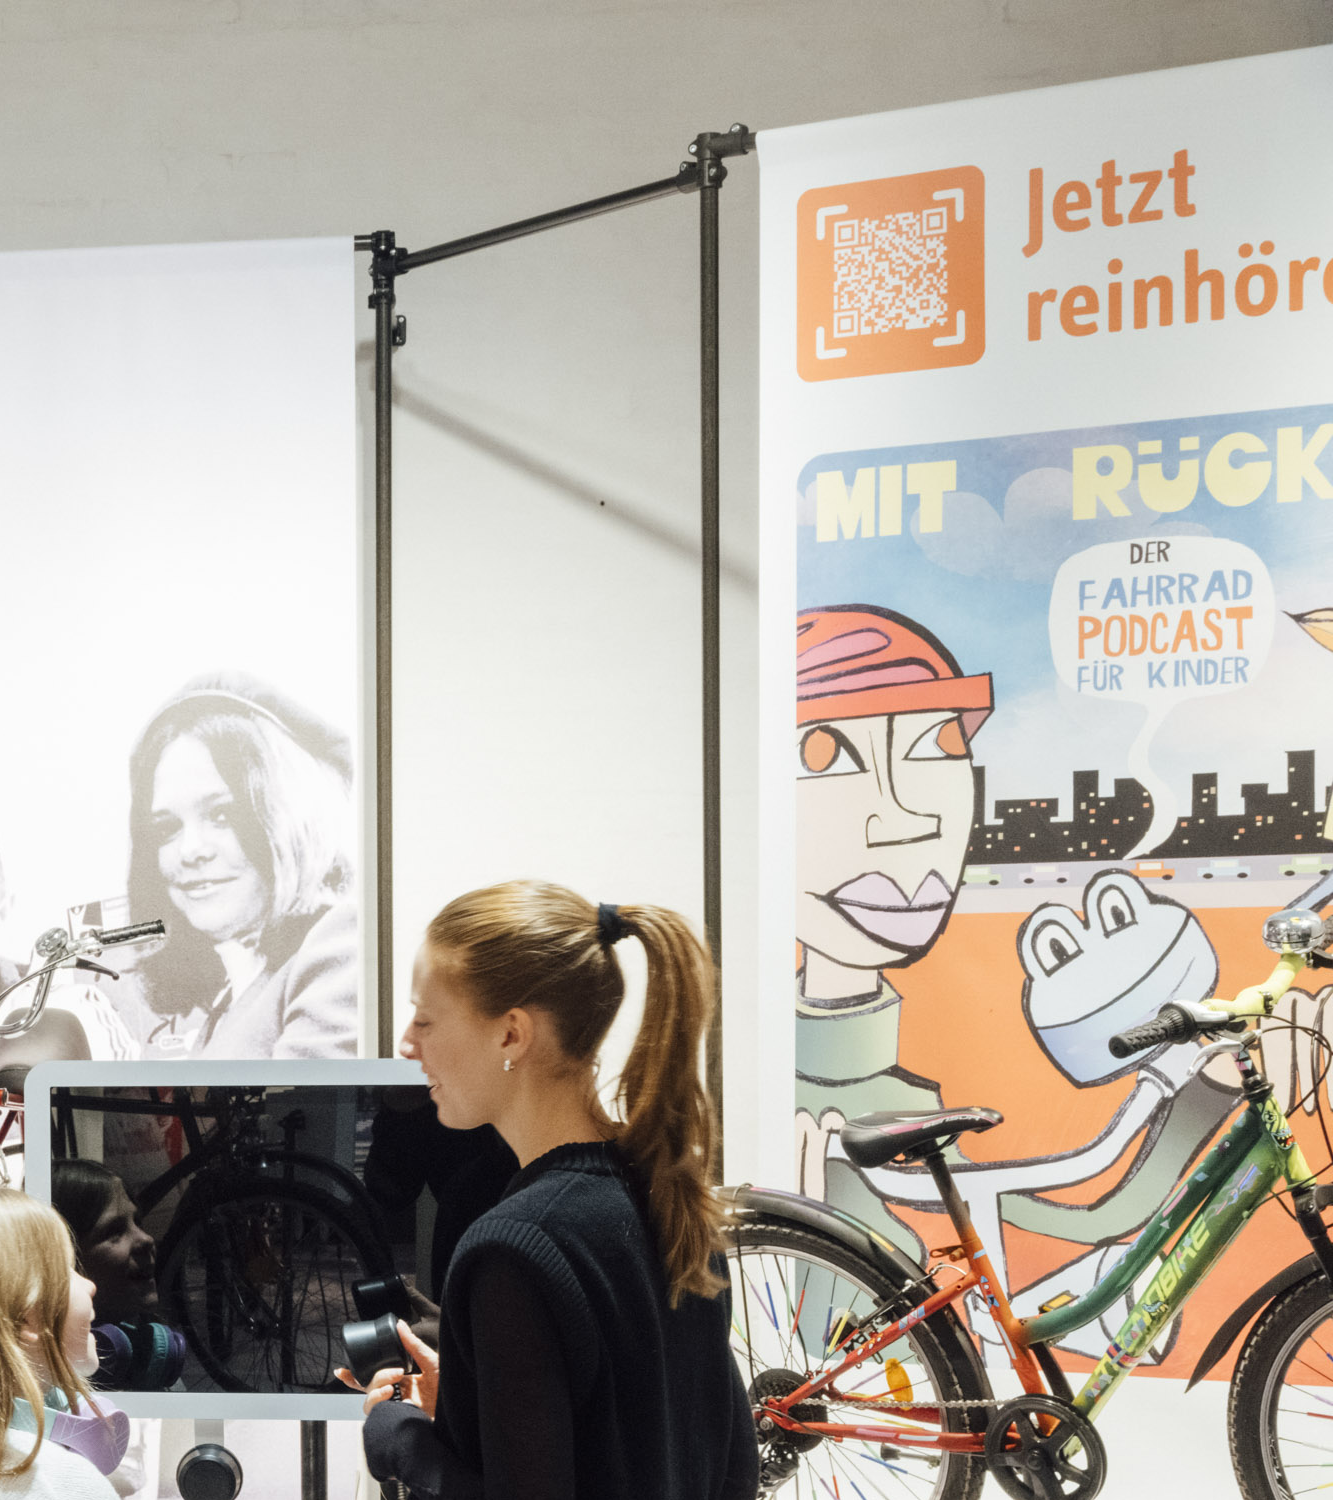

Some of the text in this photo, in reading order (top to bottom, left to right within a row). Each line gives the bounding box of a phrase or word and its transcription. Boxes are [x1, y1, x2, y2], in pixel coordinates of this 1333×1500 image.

[1022, 149, 1196, 258] Jetzt
[1027, 240, 1333, 341] reinhör
[816, 459, 957, 543] MIT
[1130, 541, 1171, 564] DER
[1079, 569, 1253, 611] FAHRRAD
[1078, 606, 1253, 659] PODCAST
[1077, 656, 1250, 693] FÜR KINDER
